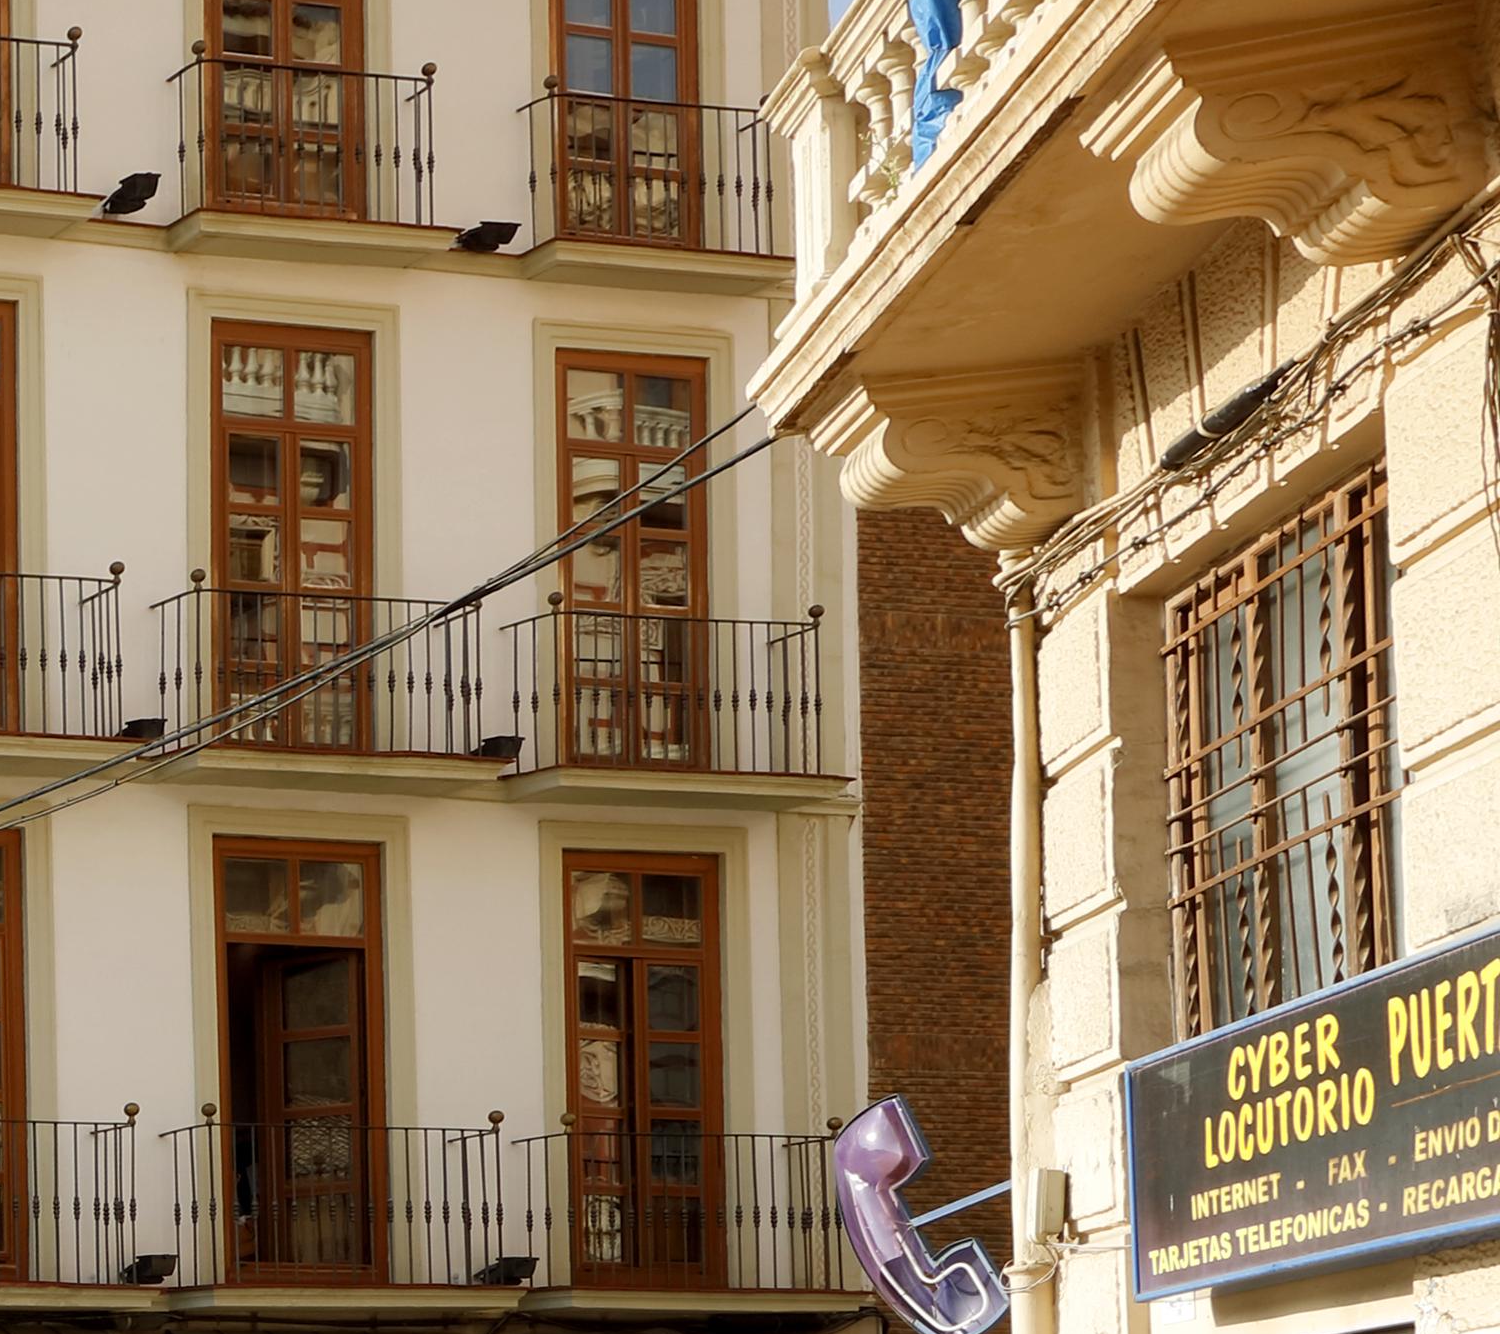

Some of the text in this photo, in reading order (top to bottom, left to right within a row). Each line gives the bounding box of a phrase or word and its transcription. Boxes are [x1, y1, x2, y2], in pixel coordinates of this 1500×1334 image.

[1228, 1014, 1341, 1101] CYBER
[1387, 958, 1500, 1086] PUERT
[1191, 1173, 1281, 1220] INTERNET
[1328, 1150, 1367, 1186] FAX
[1413, 1116, 1480, 1162] ENVIO
[1204, 1068, 1375, 1169] LOCUTORIO
[1148, 1231, 1232, 1276] TARJETAS
[1235, 1198, 1370, 1255] TELEFONICAS
